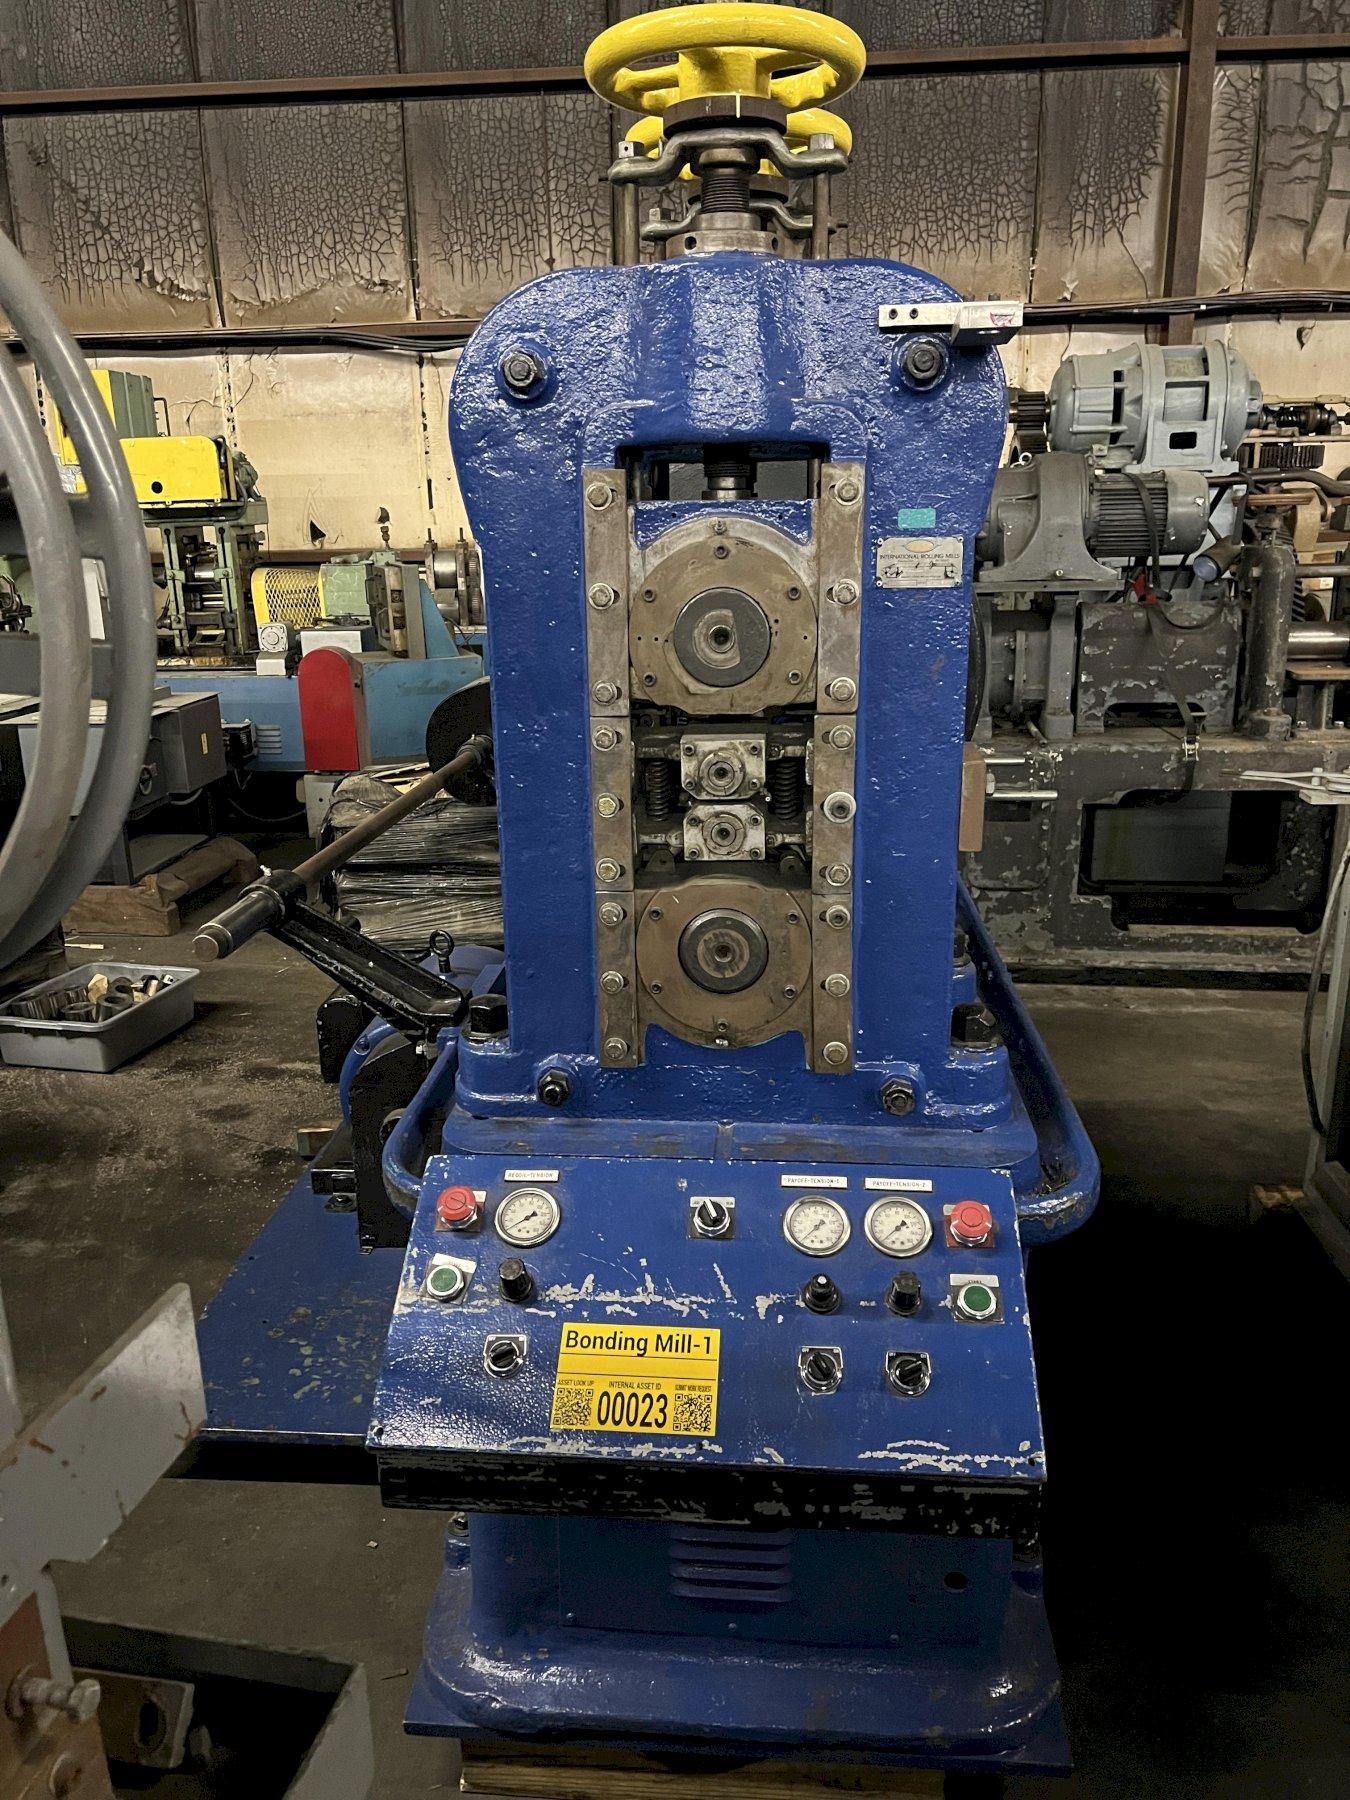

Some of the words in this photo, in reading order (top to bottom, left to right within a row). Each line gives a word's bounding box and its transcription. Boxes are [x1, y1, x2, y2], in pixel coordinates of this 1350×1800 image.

[565, 1330, 649, 1358] Bonding
[655, 1333, 712, 1355] Mill-1
[608, 1381, 636, 1390] INTERNAL
[636, 1382, 655, 1390] ASSET
[655, 1382, 662, 1390] ID
[596, 1391, 669, 1429] 00023
